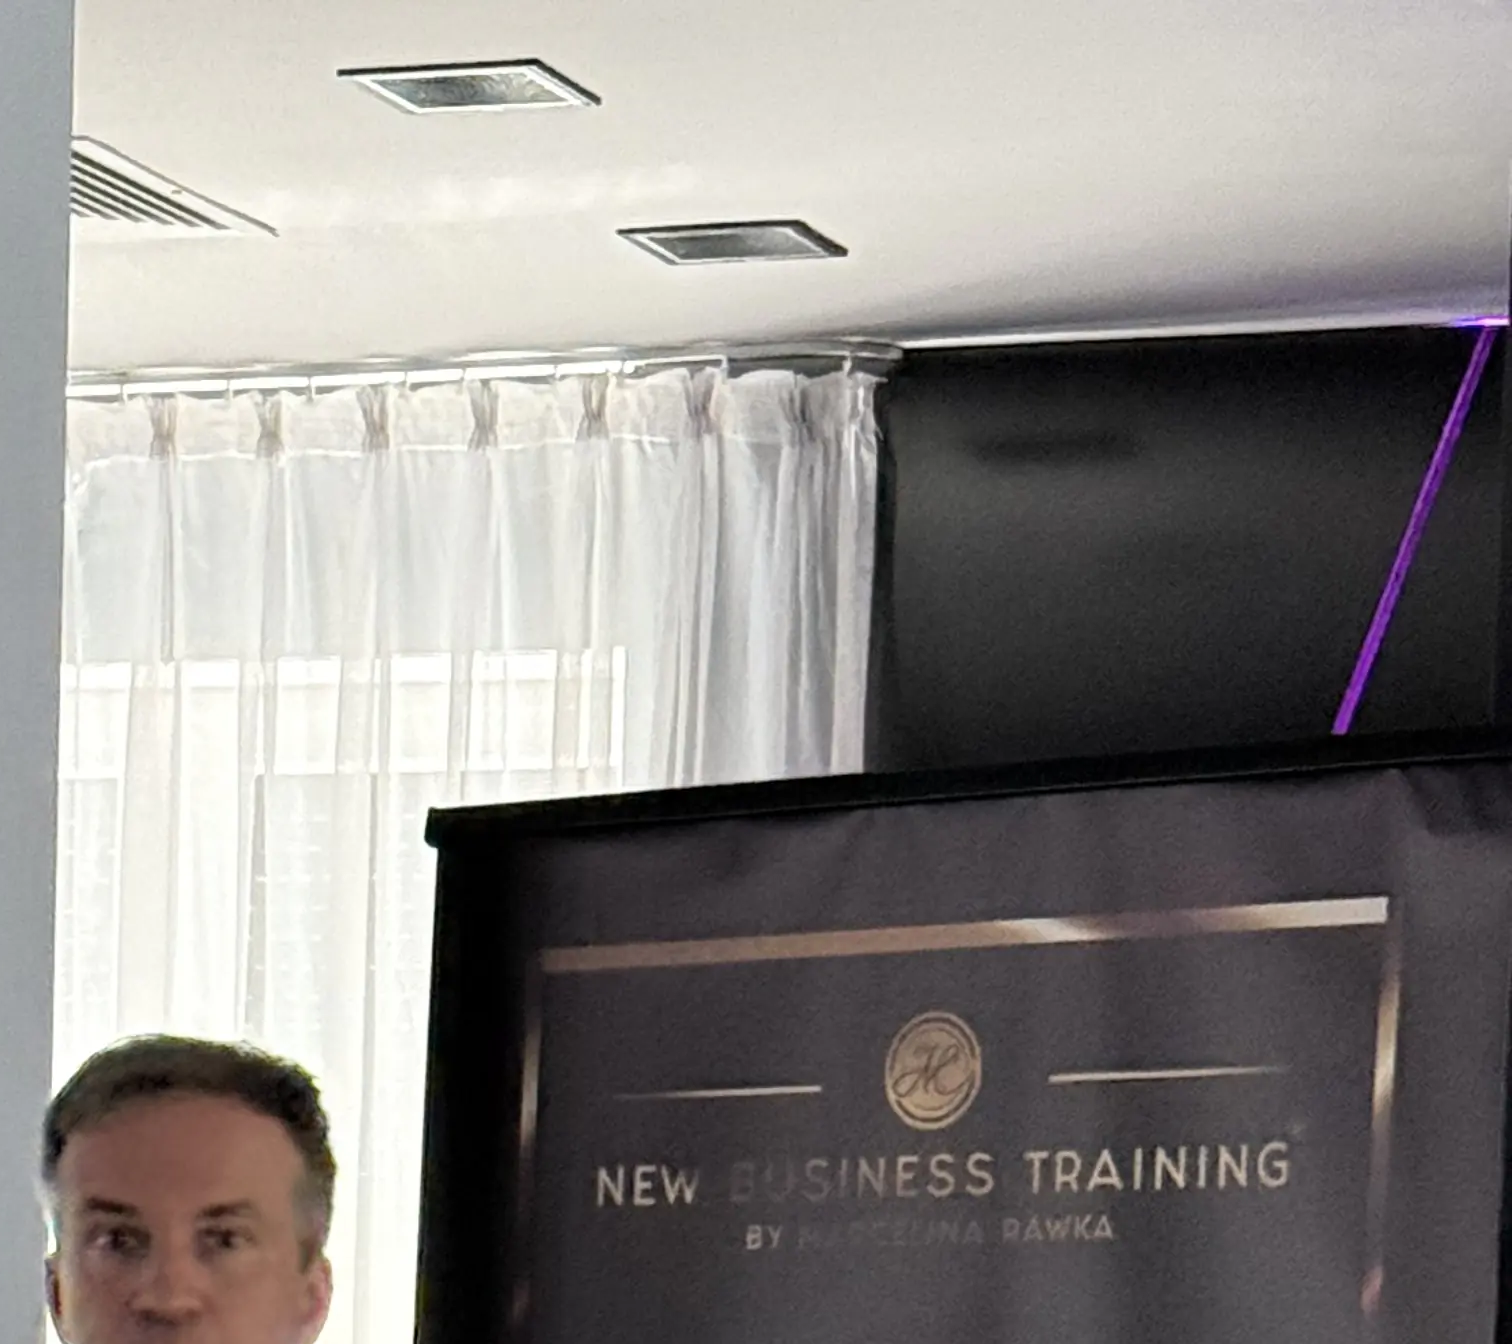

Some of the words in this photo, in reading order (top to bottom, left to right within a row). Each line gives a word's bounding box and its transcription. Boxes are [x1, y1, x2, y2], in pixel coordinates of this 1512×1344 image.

[596, 1164, 701, 1208] NEW
[728, 1151, 996, 1203] BUSINESS
[1023, 1140, 1290, 1194] TRAINING
[744, 1223, 783, 1250] BY
